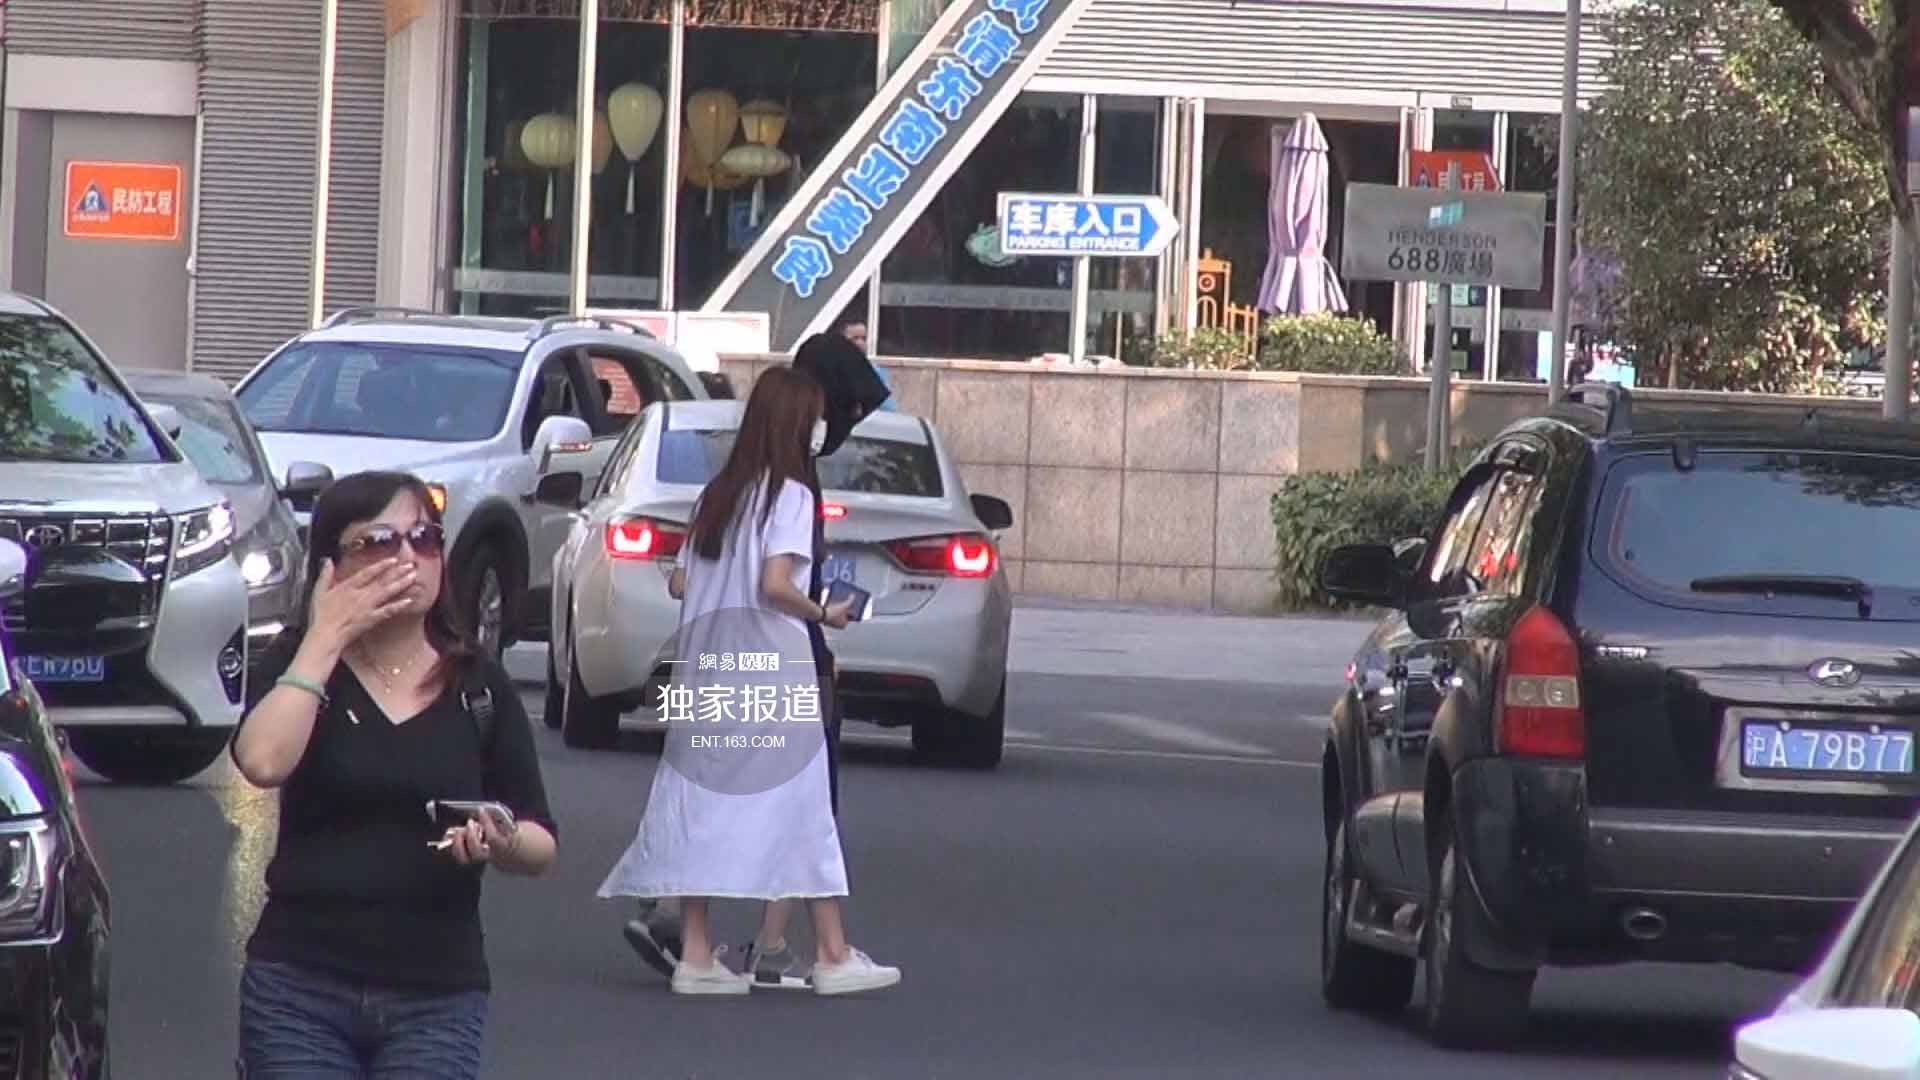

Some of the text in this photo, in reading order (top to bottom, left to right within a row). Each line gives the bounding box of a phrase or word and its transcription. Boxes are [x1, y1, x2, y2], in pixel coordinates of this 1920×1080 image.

[112, 187, 173, 215] 民防工程
[1009, 202, 1142, 236] 车库入口
[1008, 236, 1140, 250] PARKING ENTRANCE
[1388, 229, 1497, 249] HENDERSON
